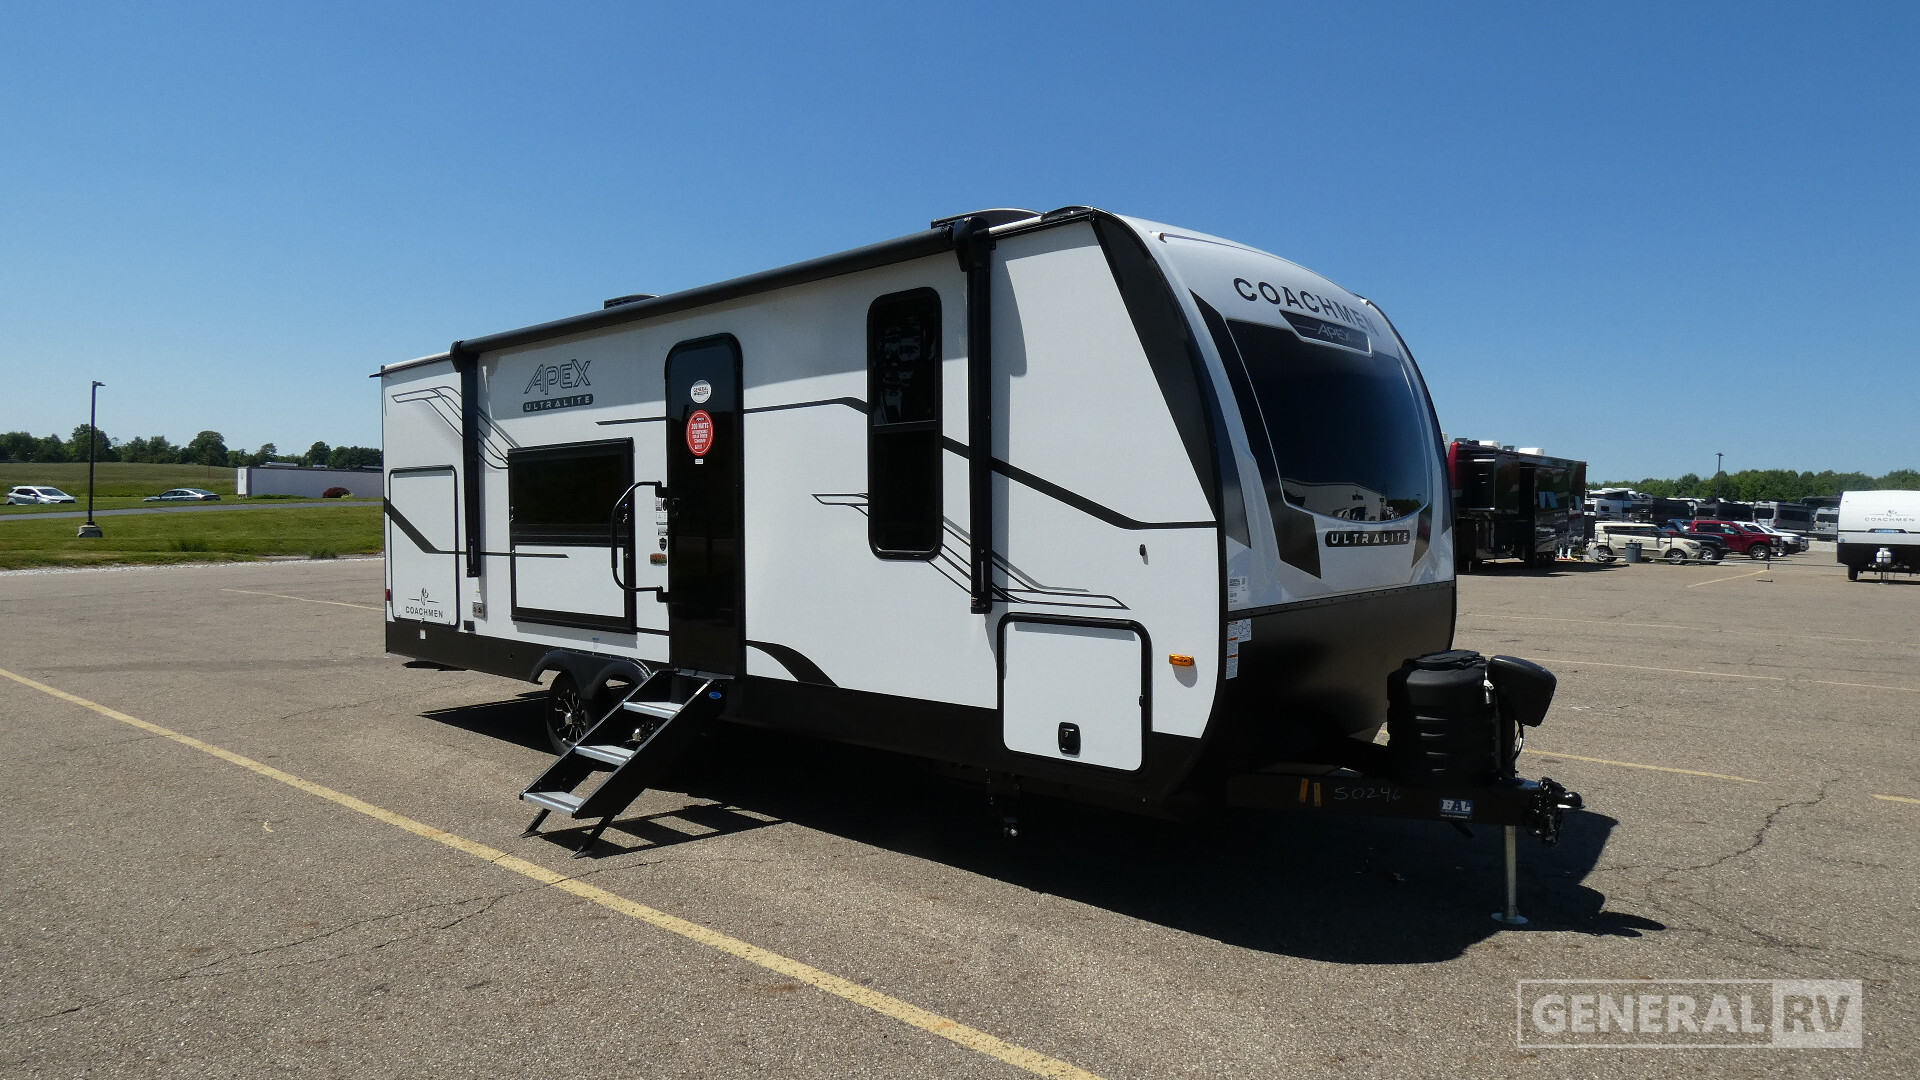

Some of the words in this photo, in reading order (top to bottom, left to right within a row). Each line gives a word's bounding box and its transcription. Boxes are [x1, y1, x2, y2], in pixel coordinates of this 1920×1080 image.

[1233, 277, 1380, 337] COACHMEN
[1317, 323, 1350, 341] APEX
[523, 358, 592, 396] APEX
[525, 395, 591, 411] ULTRALITE
[1331, 532, 1408, 545] ULTRALITE
[405, 605, 443, 618] COACHMEN
[1334, 786, 1400, 801] 50246
